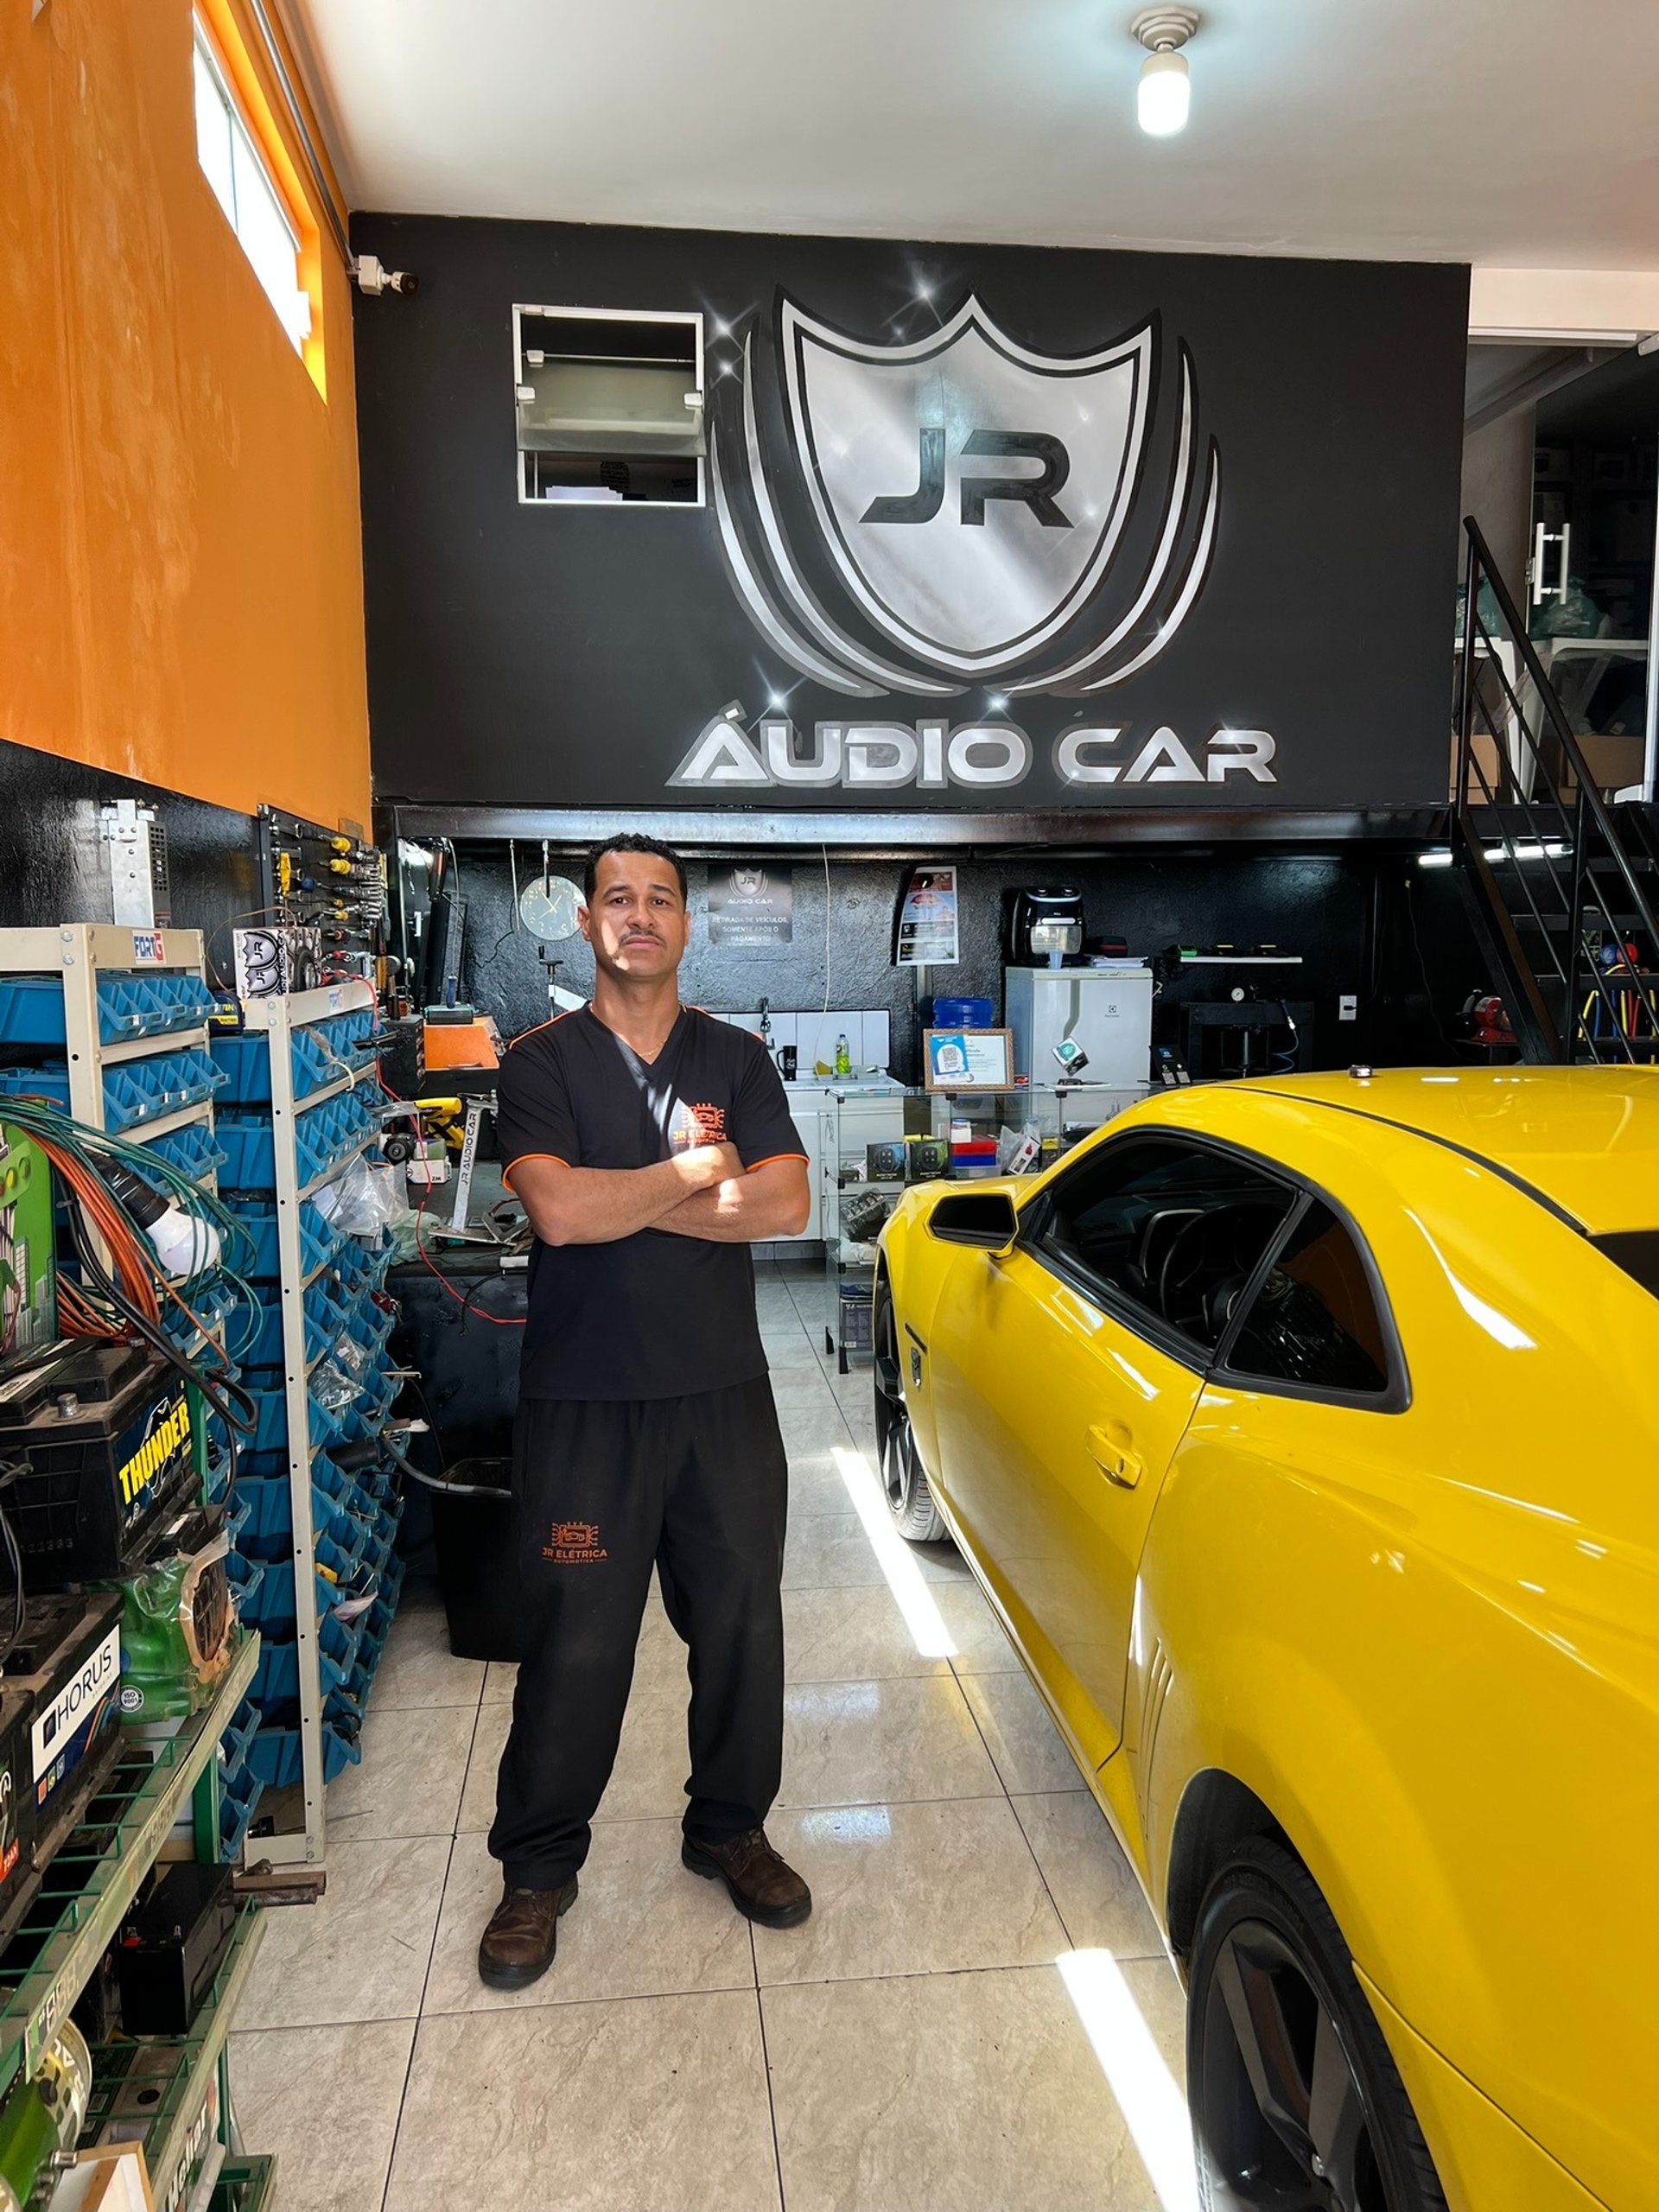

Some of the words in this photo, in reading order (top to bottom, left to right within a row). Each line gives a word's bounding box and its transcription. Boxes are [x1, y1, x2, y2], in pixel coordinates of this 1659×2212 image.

[858, 426, 1075, 529] JR
[668, 702, 1029, 790] ÁUDIO
[1055, 722, 1279, 785] CAR
[740, 876, 757, 885] JR
[253, 941, 264, 960] JR
[467, 1113, 477, 1136] CAR
[462, 1136, 474, 1171] AUDIO
[461, 1172, 468, 1185] JR
[118, 1401, 191, 1505] THUNDER
[541, 1547, 554, 1557] JR
[556, 1548, 608, 1559] ELÉTRICA
[57, 1643, 112, 1731] HORUS
[123, 1696, 138, 1705] 9001
